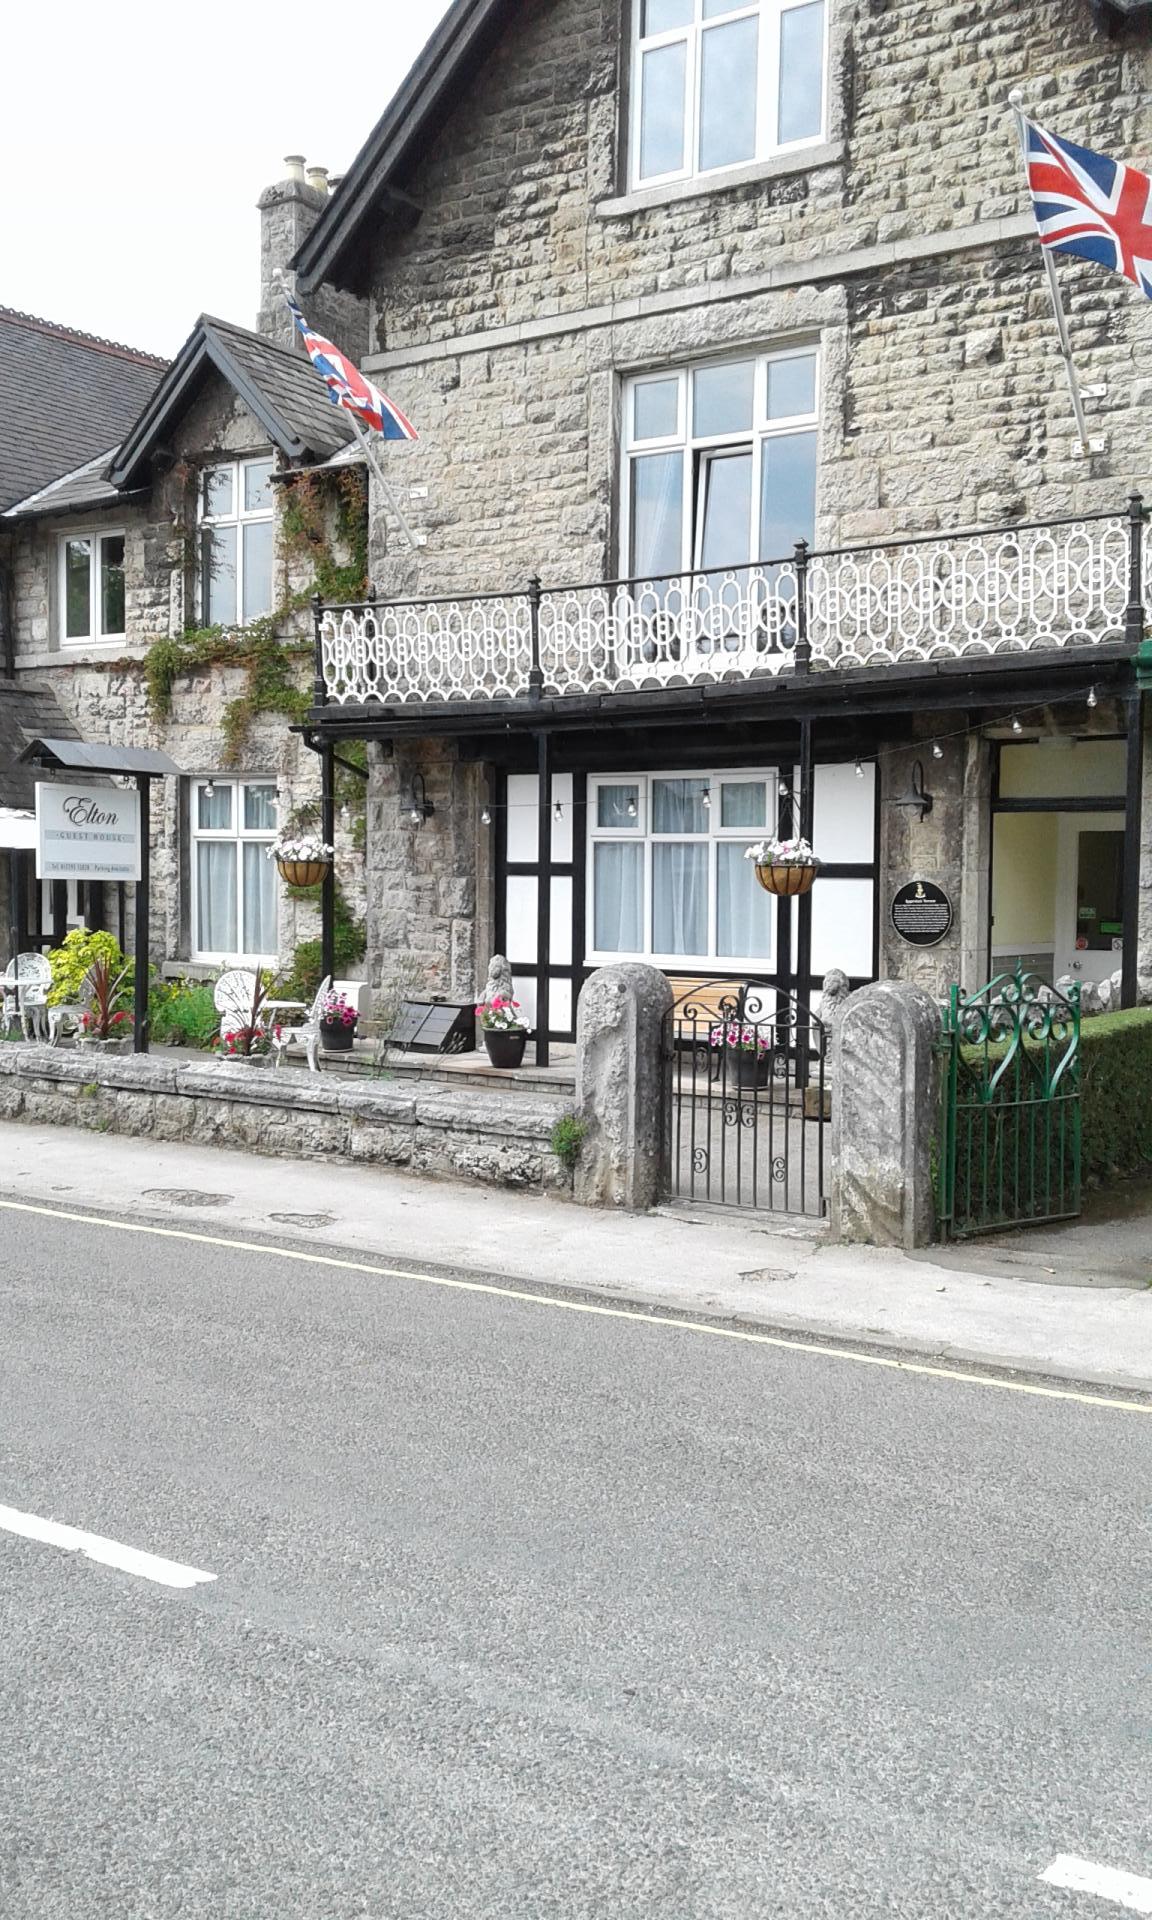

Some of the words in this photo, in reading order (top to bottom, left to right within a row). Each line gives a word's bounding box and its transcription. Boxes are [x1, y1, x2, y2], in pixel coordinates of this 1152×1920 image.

[63, 796, 119, 826] Elton
[60, 831, 88, 840] GUEST
[93, 832, 122, 842] HOUSE
